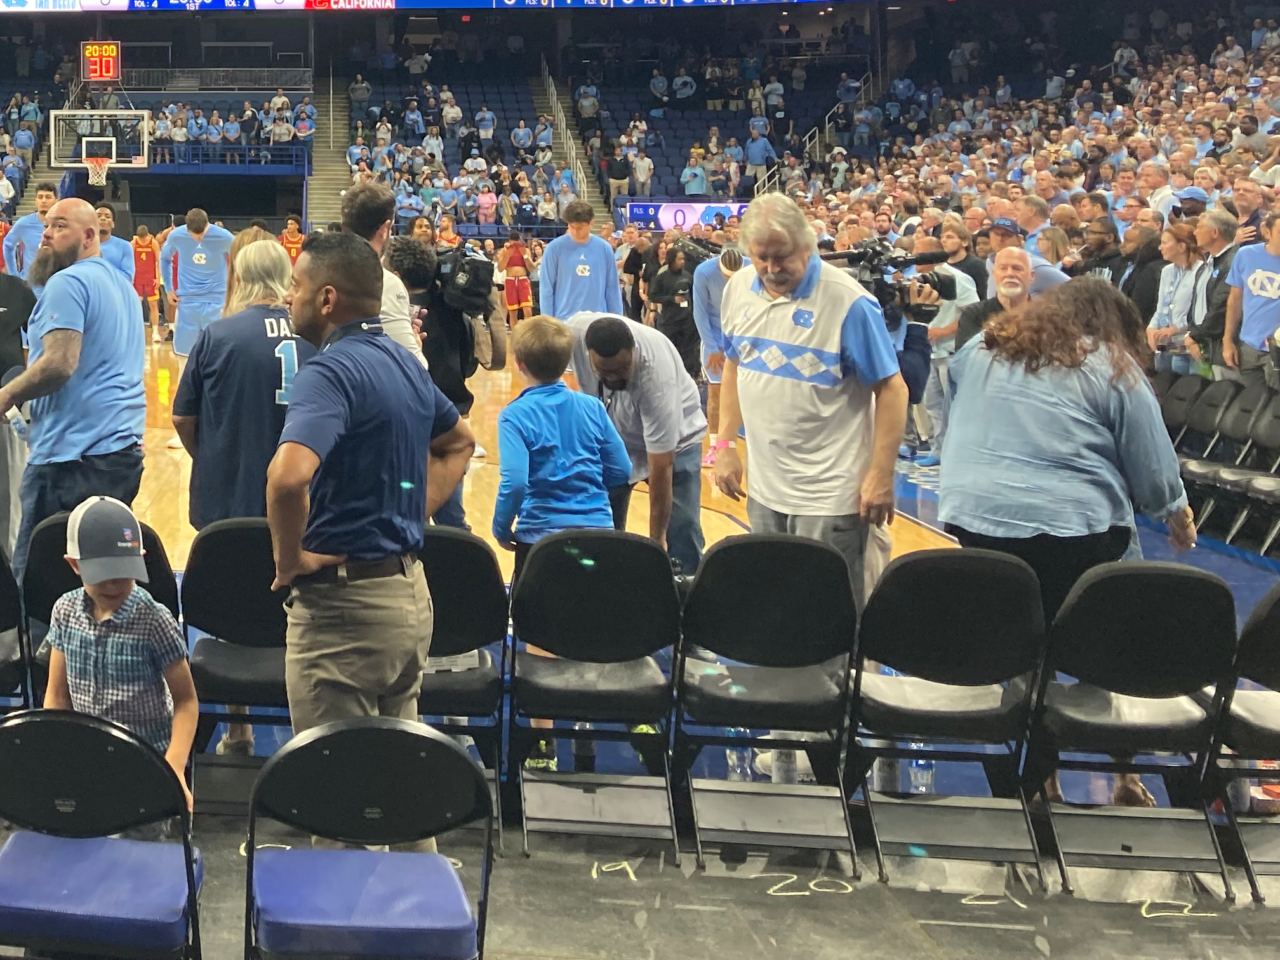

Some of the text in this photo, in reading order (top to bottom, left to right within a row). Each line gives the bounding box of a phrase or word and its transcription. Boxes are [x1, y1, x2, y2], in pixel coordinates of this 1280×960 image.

[151, 0, 158, 8] 4
[85, 45, 116, 57] 20:00
[89, 58, 114, 77] 30
[649, 221, 655, 229] 4
[674, 209, 686, 227] 0
[140, 252, 146, 261] 4
[290, 248, 297, 258] 0
[265, 317, 301, 337] DA
[275, 339, 298, 405] 1
[591, 861, 637, 882] 19
[750, 873, 853, 896] 20
